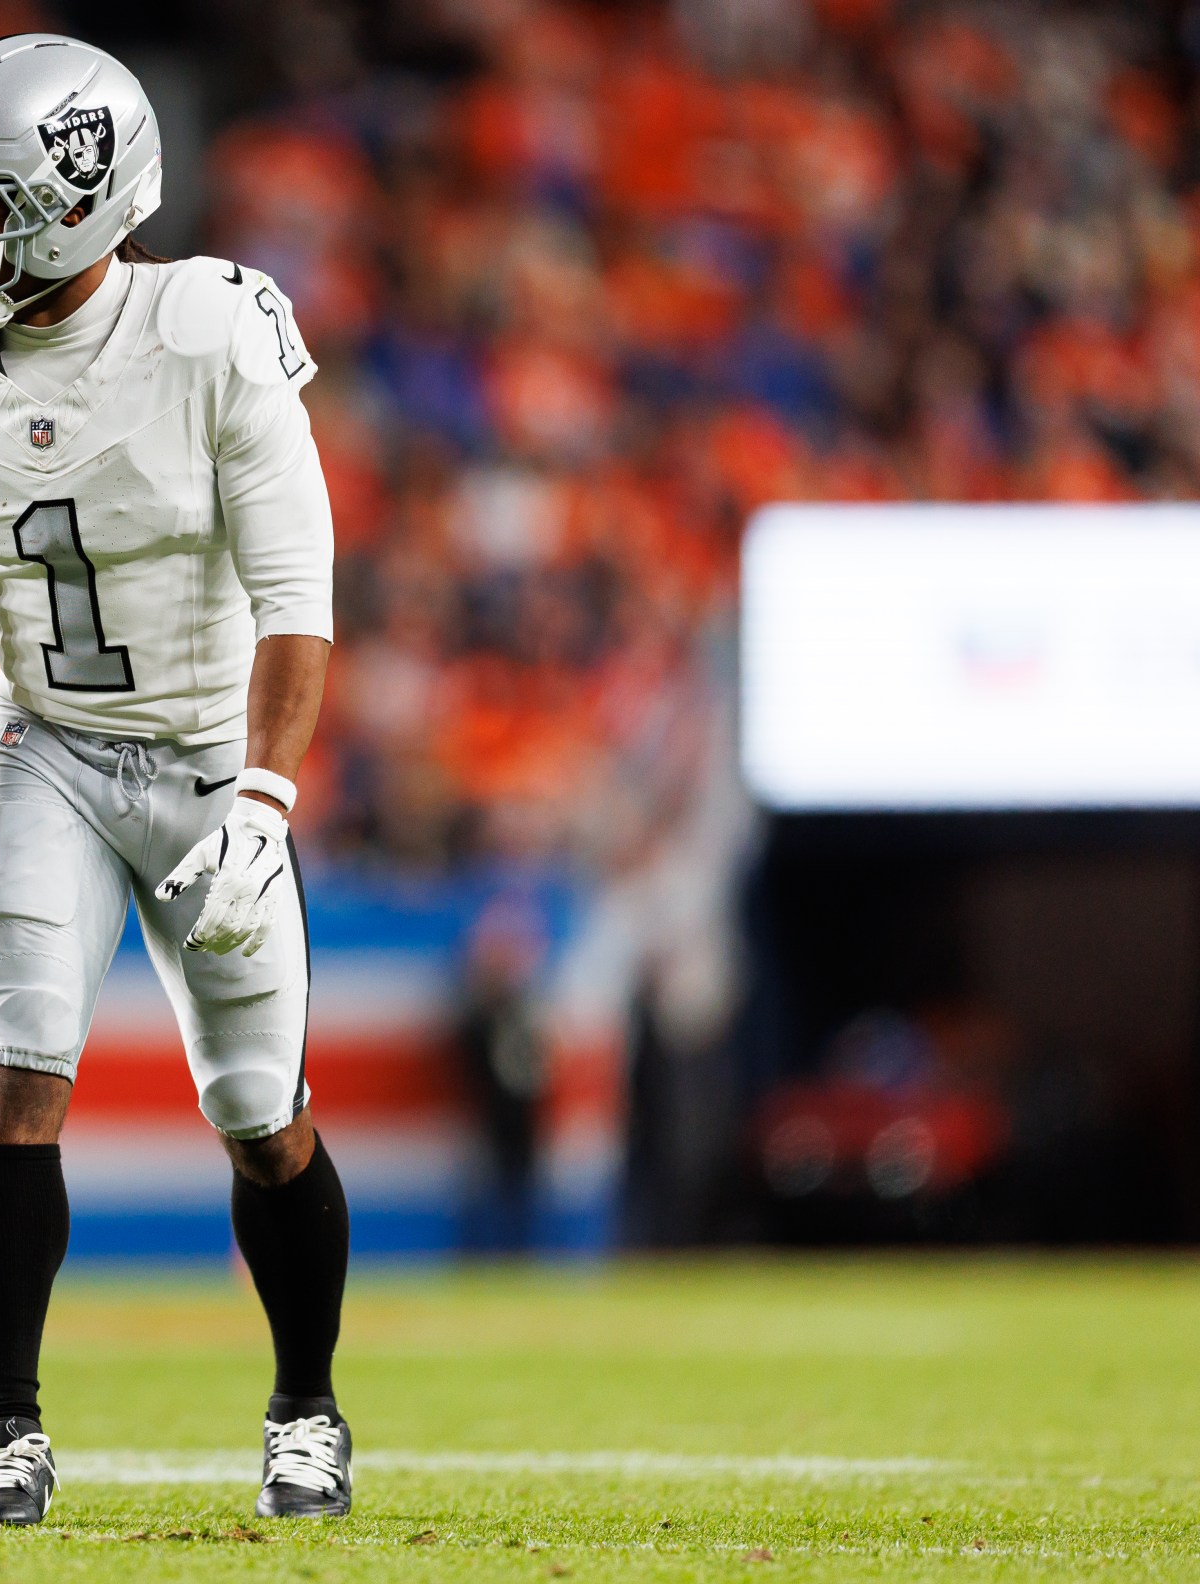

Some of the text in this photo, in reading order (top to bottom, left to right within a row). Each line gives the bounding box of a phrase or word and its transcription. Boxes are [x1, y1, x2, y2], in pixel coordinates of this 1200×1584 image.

[46, 109, 105, 134] RAIDERS
[255, 287, 306, 380] 1
[32, 431, 51, 445] NFL
[12, 498, 135, 691] 1
